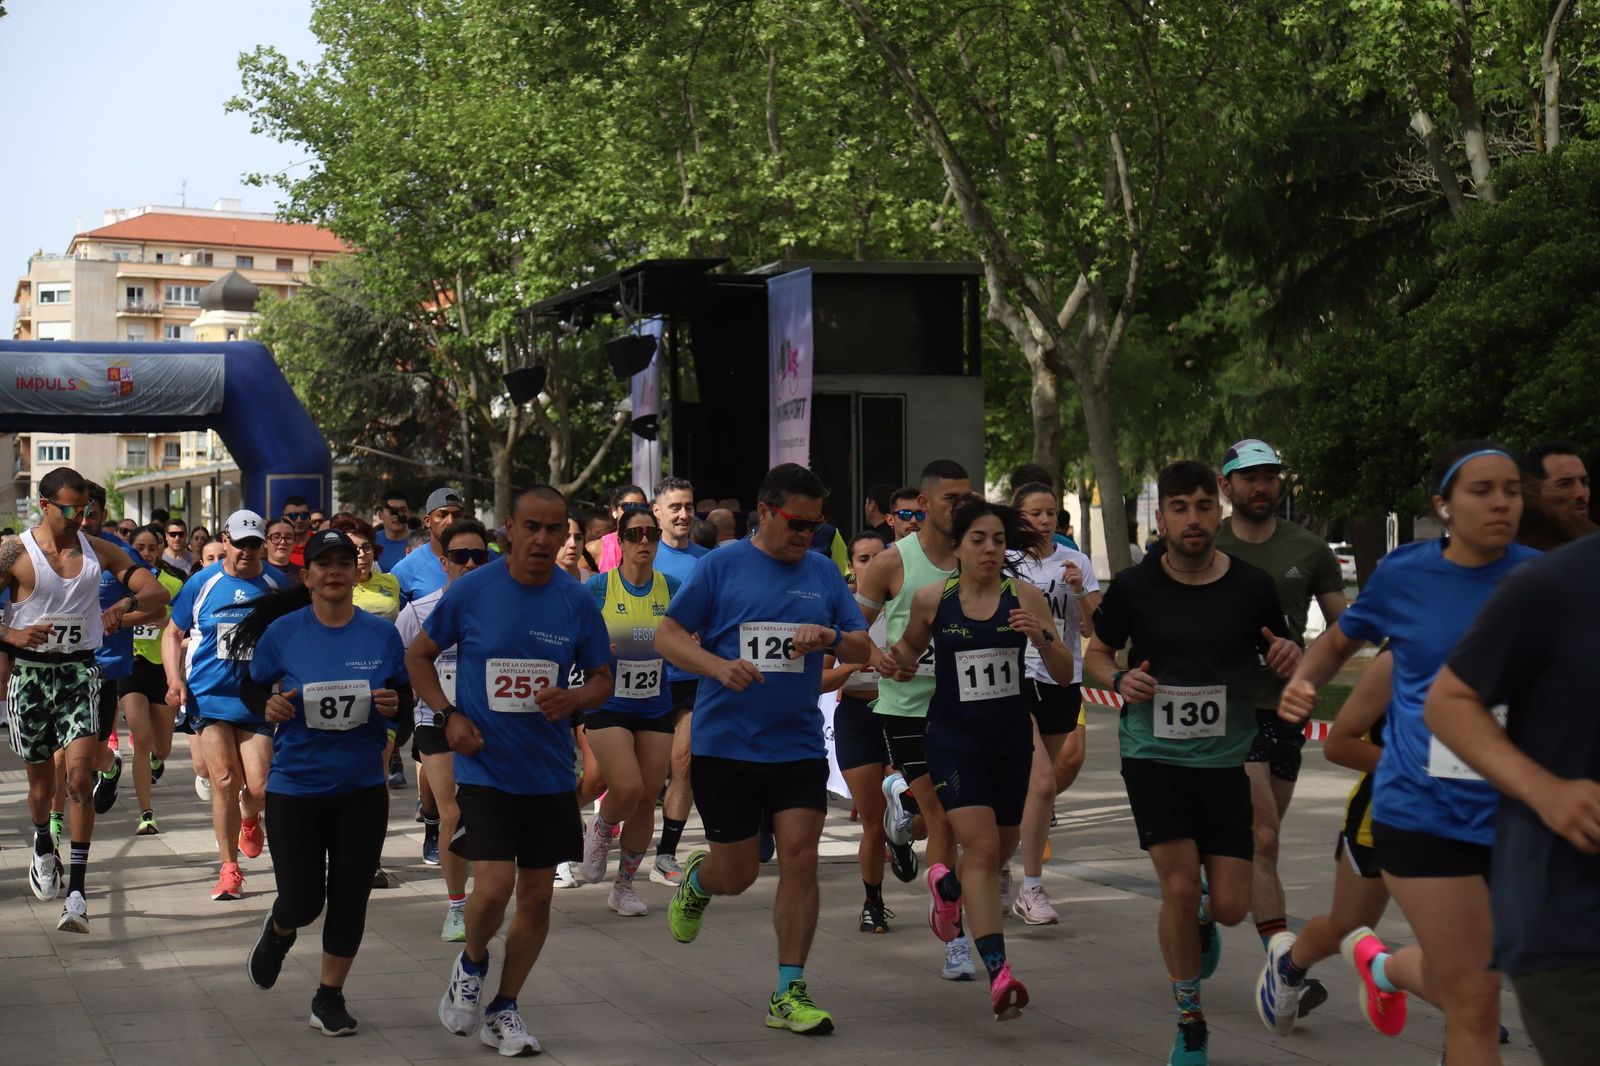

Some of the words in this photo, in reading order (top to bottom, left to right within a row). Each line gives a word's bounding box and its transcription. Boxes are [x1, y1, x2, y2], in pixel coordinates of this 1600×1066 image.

[54, 625, 82, 645] 75
[747, 636, 797, 660] 126
[977, 651, 998, 660] CASTILLA
[531, 667, 548, 675] LEÓN
[622, 670, 658, 690] 123
[965, 660, 1011, 688] 111
[353, 682, 368, 690] LEÓN
[494, 675, 550, 699] 253
[320, 695, 357, 720] 87
[1161, 700, 1221, 727] 130
